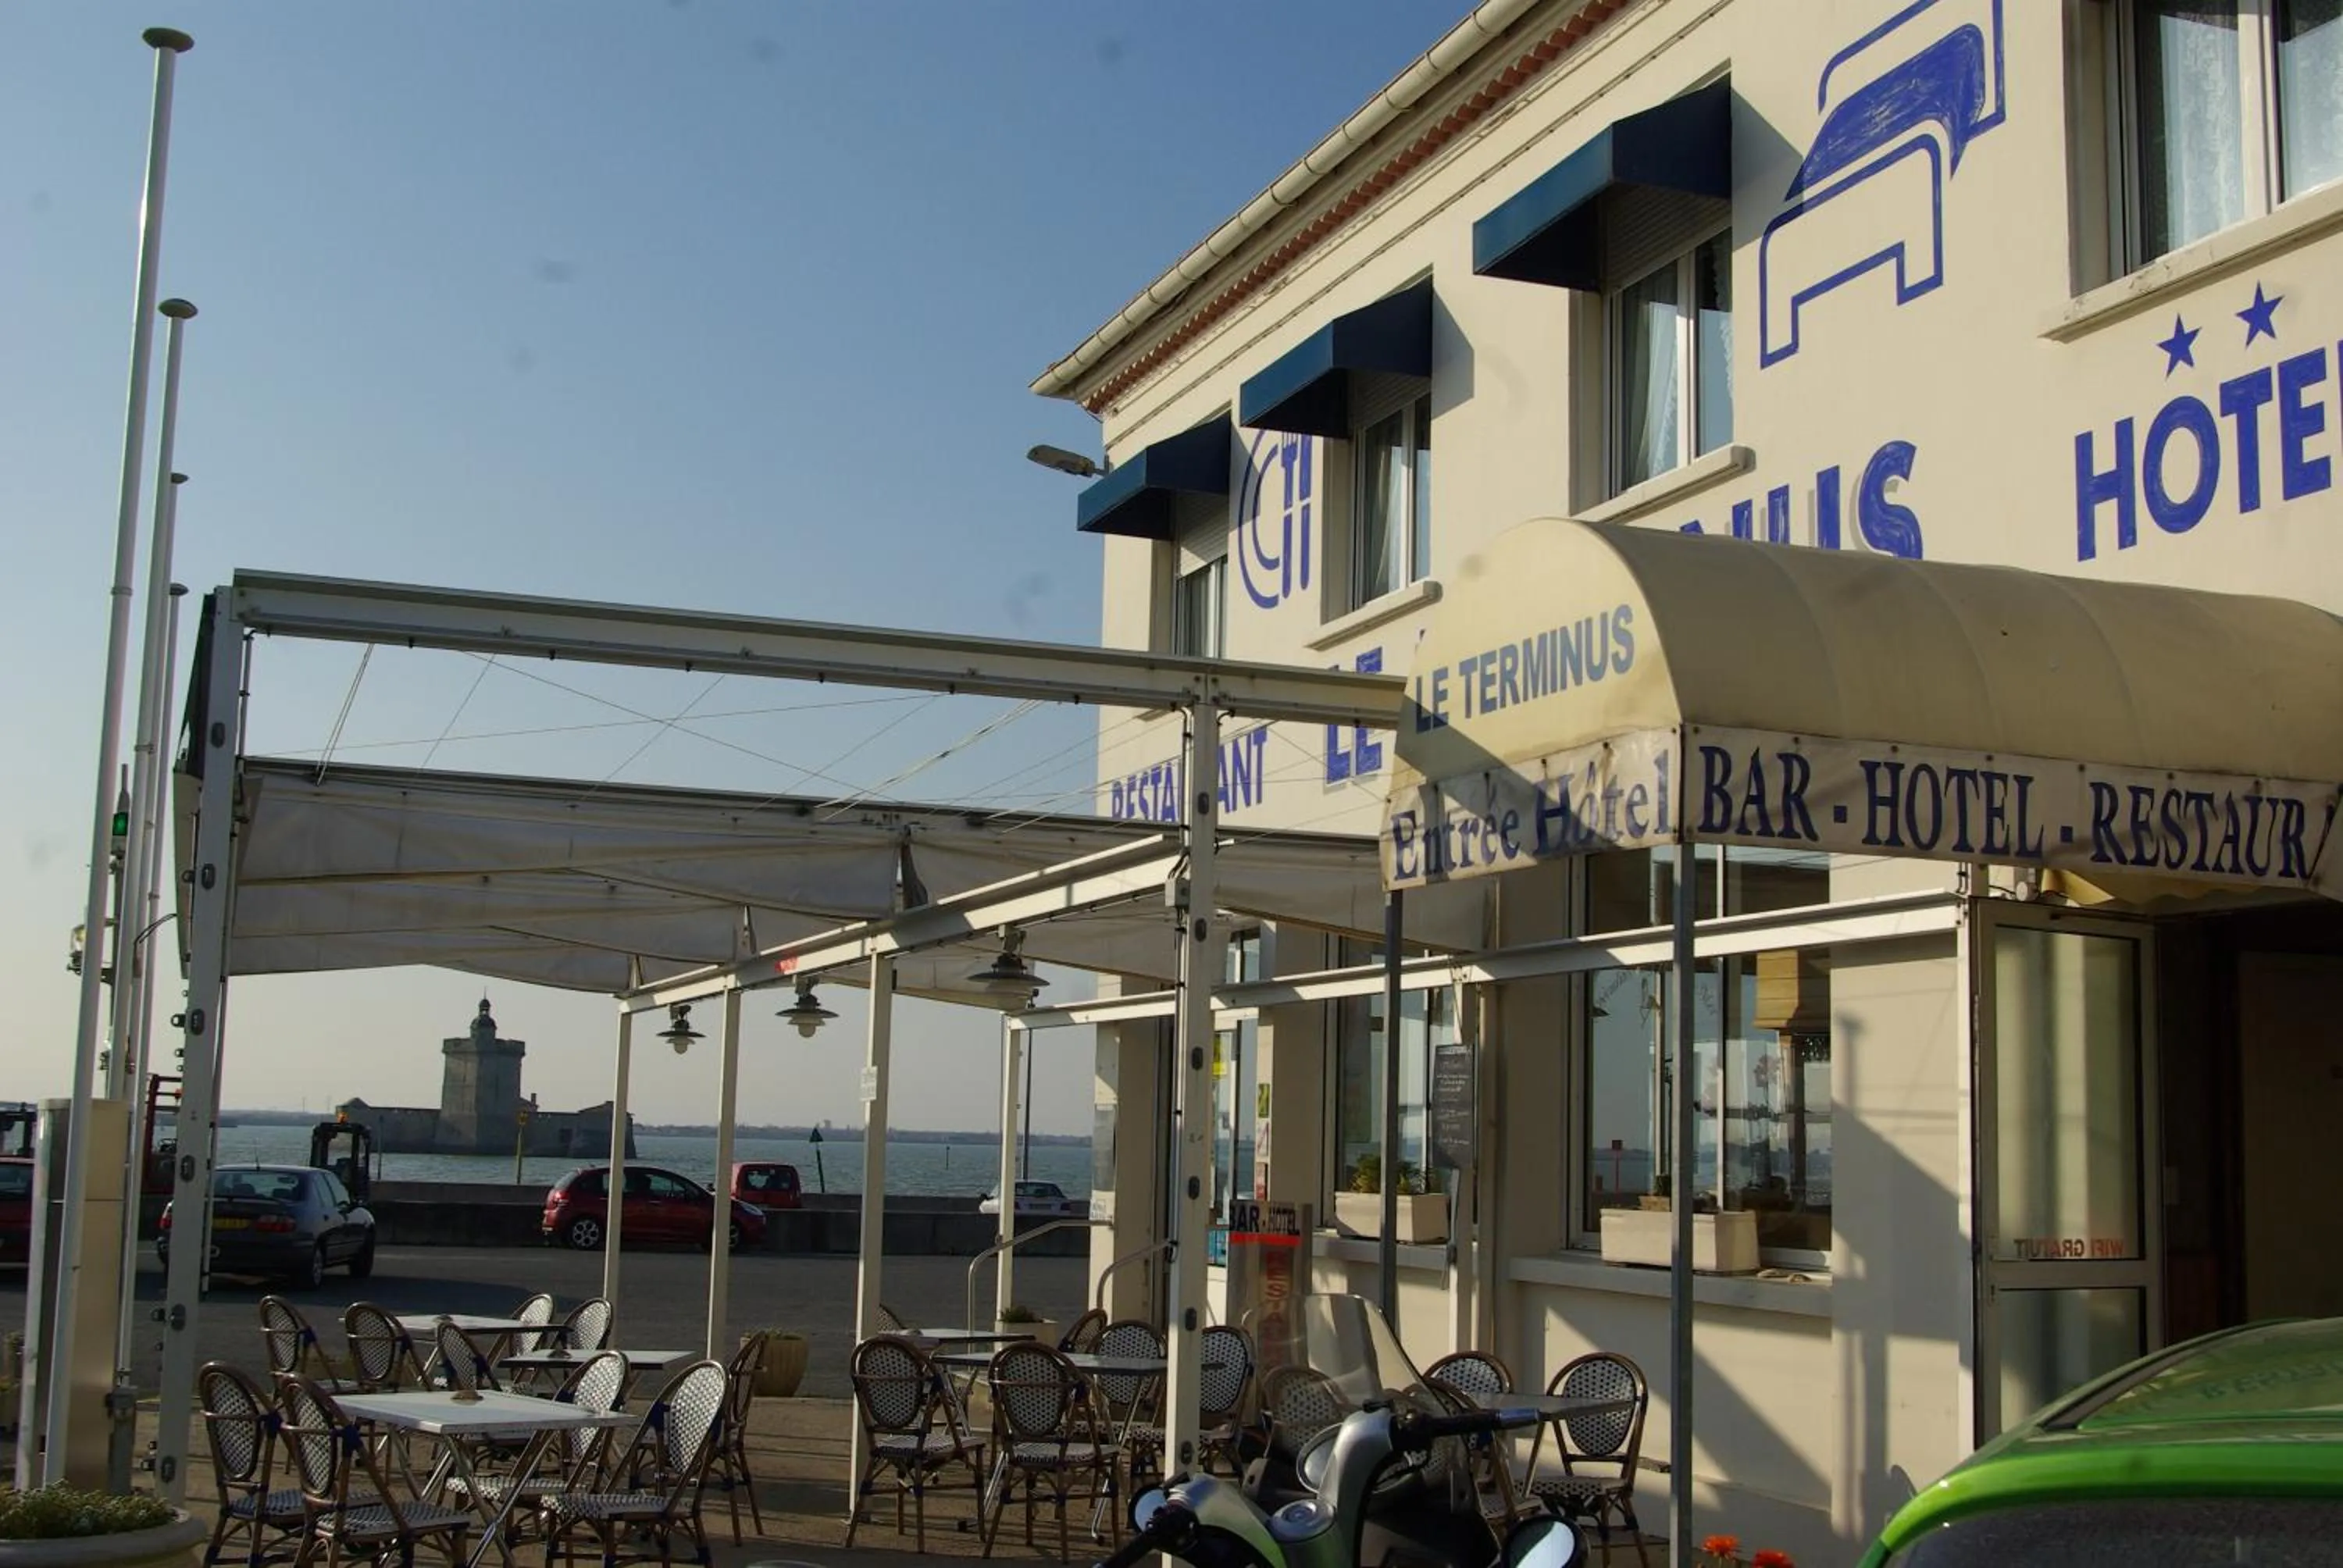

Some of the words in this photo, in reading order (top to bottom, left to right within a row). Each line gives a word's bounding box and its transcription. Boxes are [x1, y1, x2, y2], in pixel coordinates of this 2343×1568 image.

[2074, 339, 2343, 562] HOTE
[1415, 667, 1449, 734] LE
[1459, 604, 1635, 719] TERMINUS
[1112, 725, 1268, 824] RESTAANT
[1532, 749, 1670, 857] Hôtel
[1697, 746, 1820, 842] BAR
[1860, 759, 2045, 858] HOTEL
[1229, 1203, 1260, 1233] BAR
